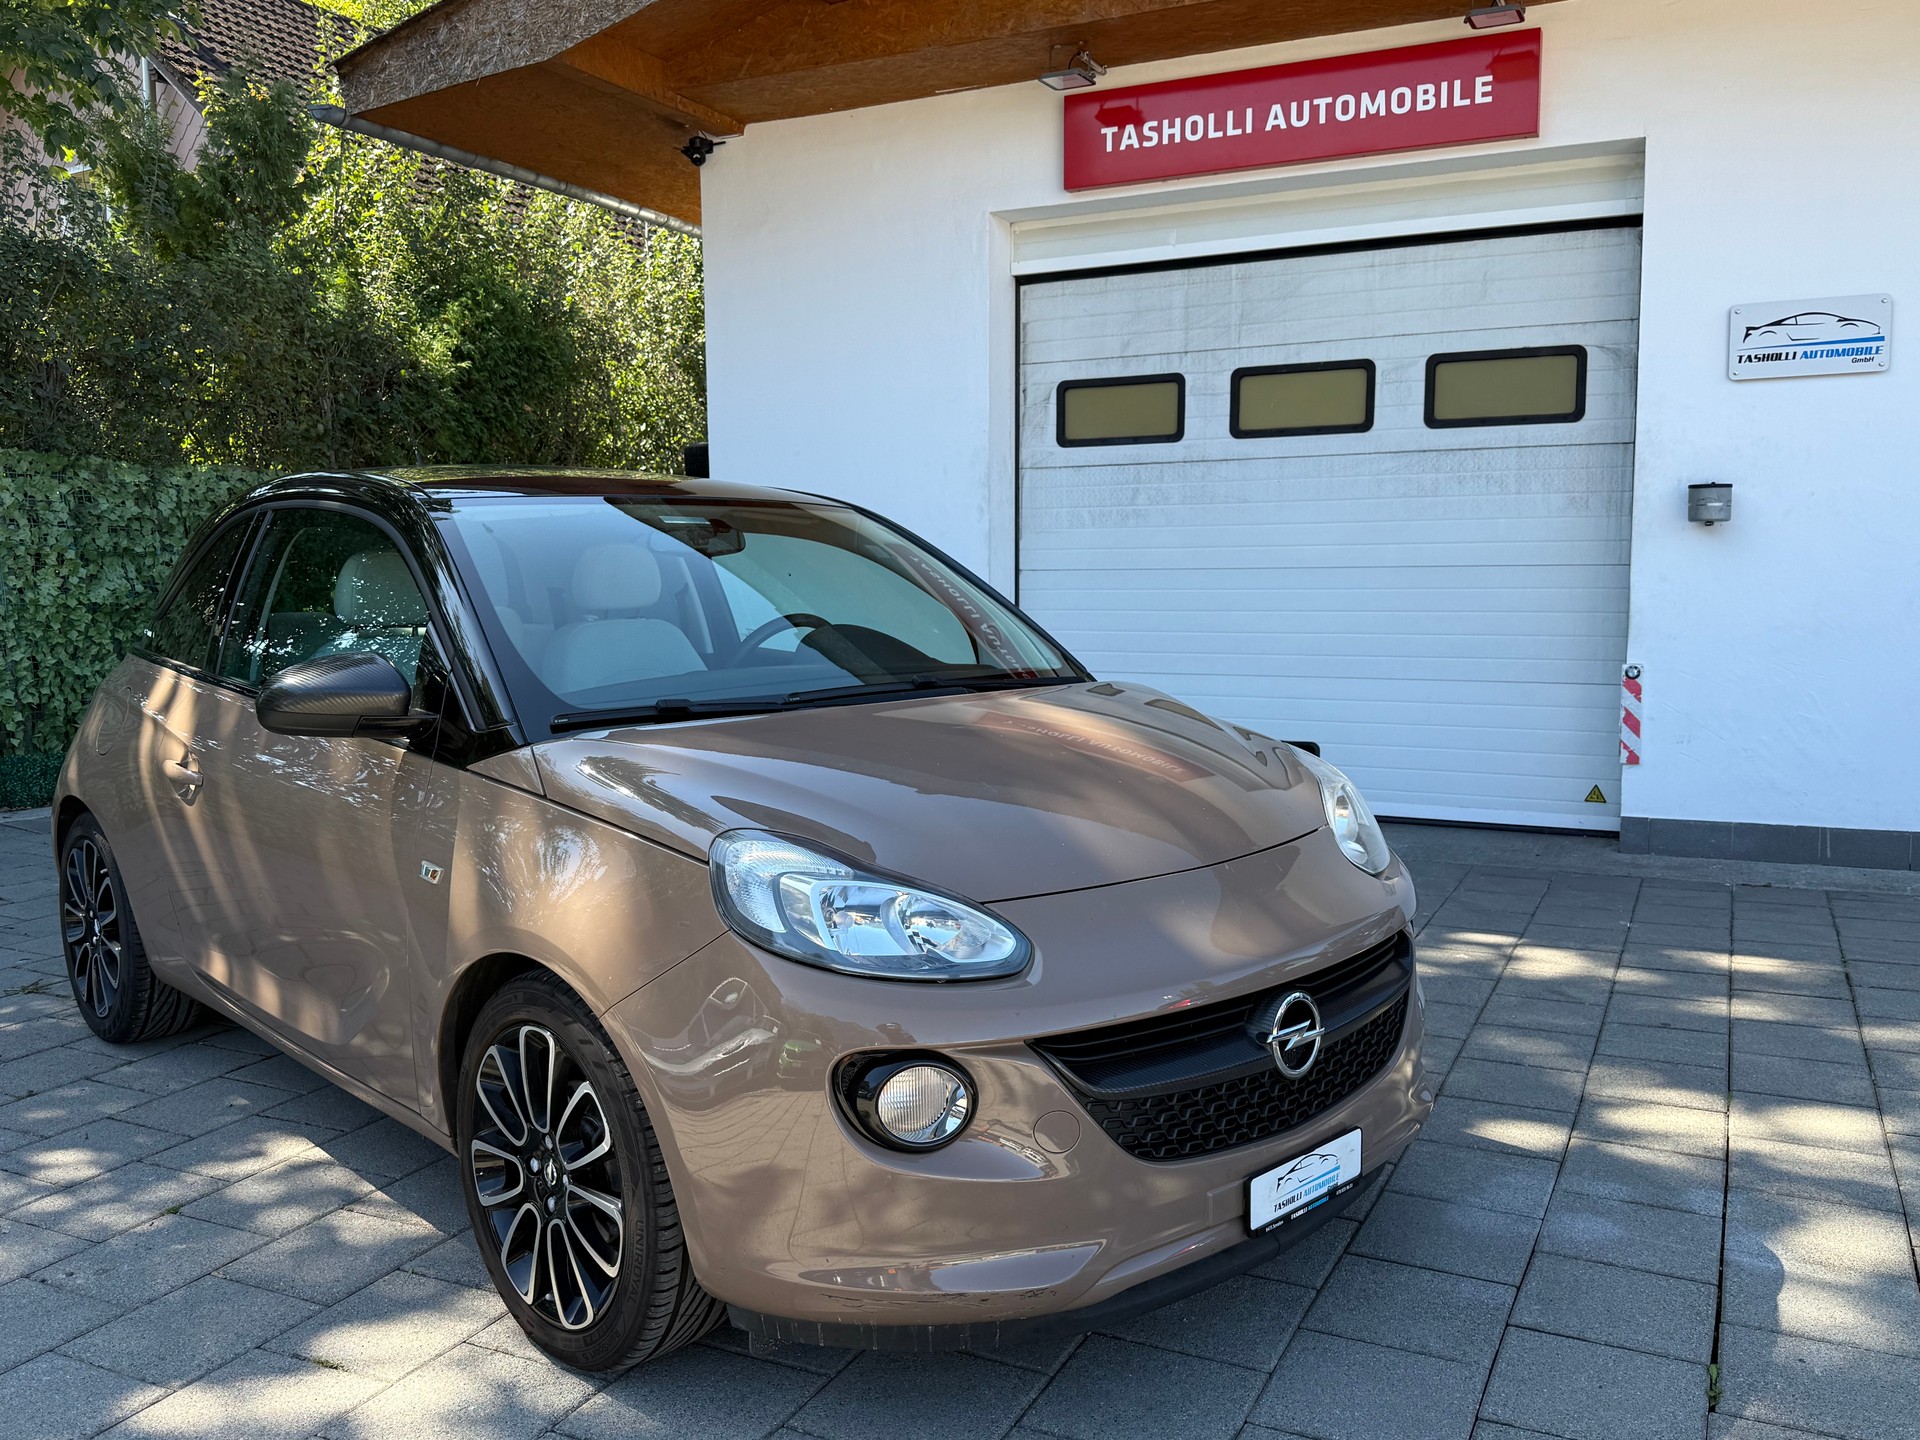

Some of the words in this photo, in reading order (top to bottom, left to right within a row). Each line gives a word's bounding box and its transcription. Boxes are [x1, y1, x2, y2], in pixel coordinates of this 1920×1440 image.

[1100, 107, 1253, 153] TASHOLLI
[1264, 75, 1494, 132] AUTOMOBILE
[1737, 351, 1797, 364] TASHOLLI
[1800, 345, 1884, 360] AUTOMOBILE
[1851, 356, 1875, 364] GmbH
[1273, 1192, 1303, 1213] TASHOLLI
[1303, 1173, 1340, 1198] AUTOMOBILE
[627, 1220, 645, 1305] UNIROYAL
